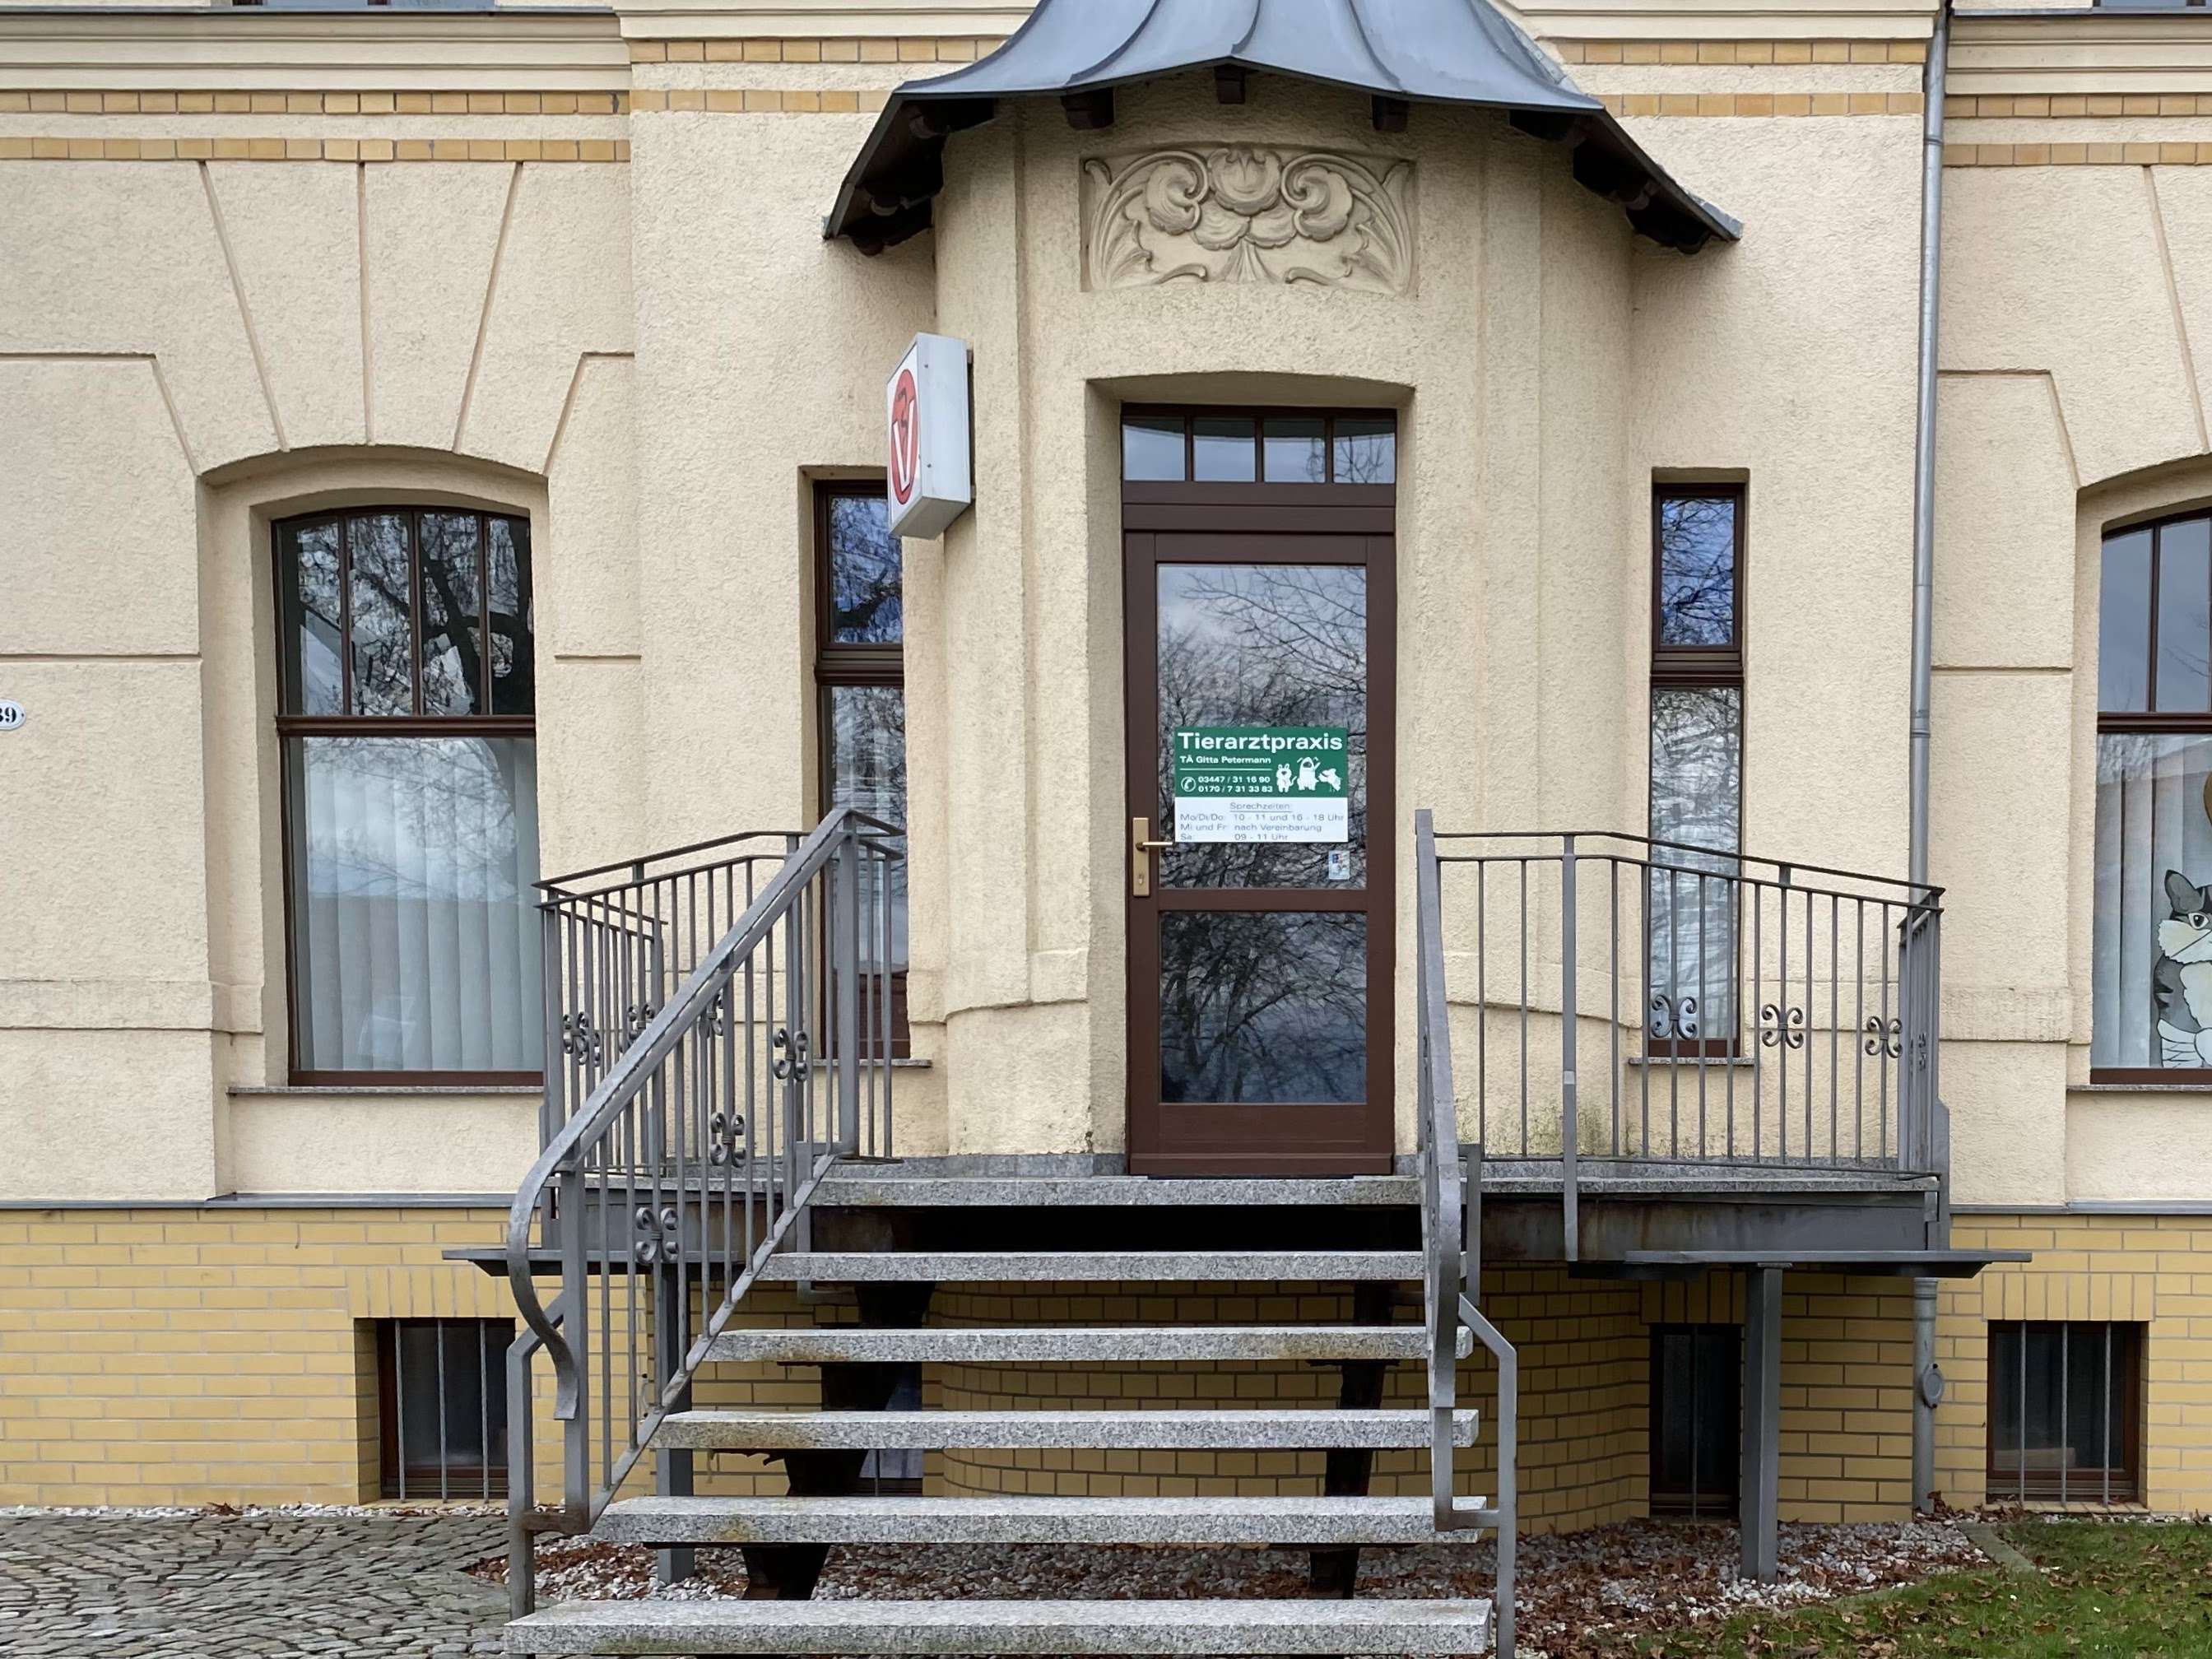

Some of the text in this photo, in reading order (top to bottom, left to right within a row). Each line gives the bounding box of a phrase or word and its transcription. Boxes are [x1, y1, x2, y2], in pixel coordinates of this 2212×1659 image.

[0, 707, 16, 723] 9
[1178, 732, 1343, 753] Tierarztpraxis
[1196, 755, 1219, 764] Gitta
[1221, 755, 1271, 764] Petermann
[1260, 824, 1322, 833] Vereinbarung
